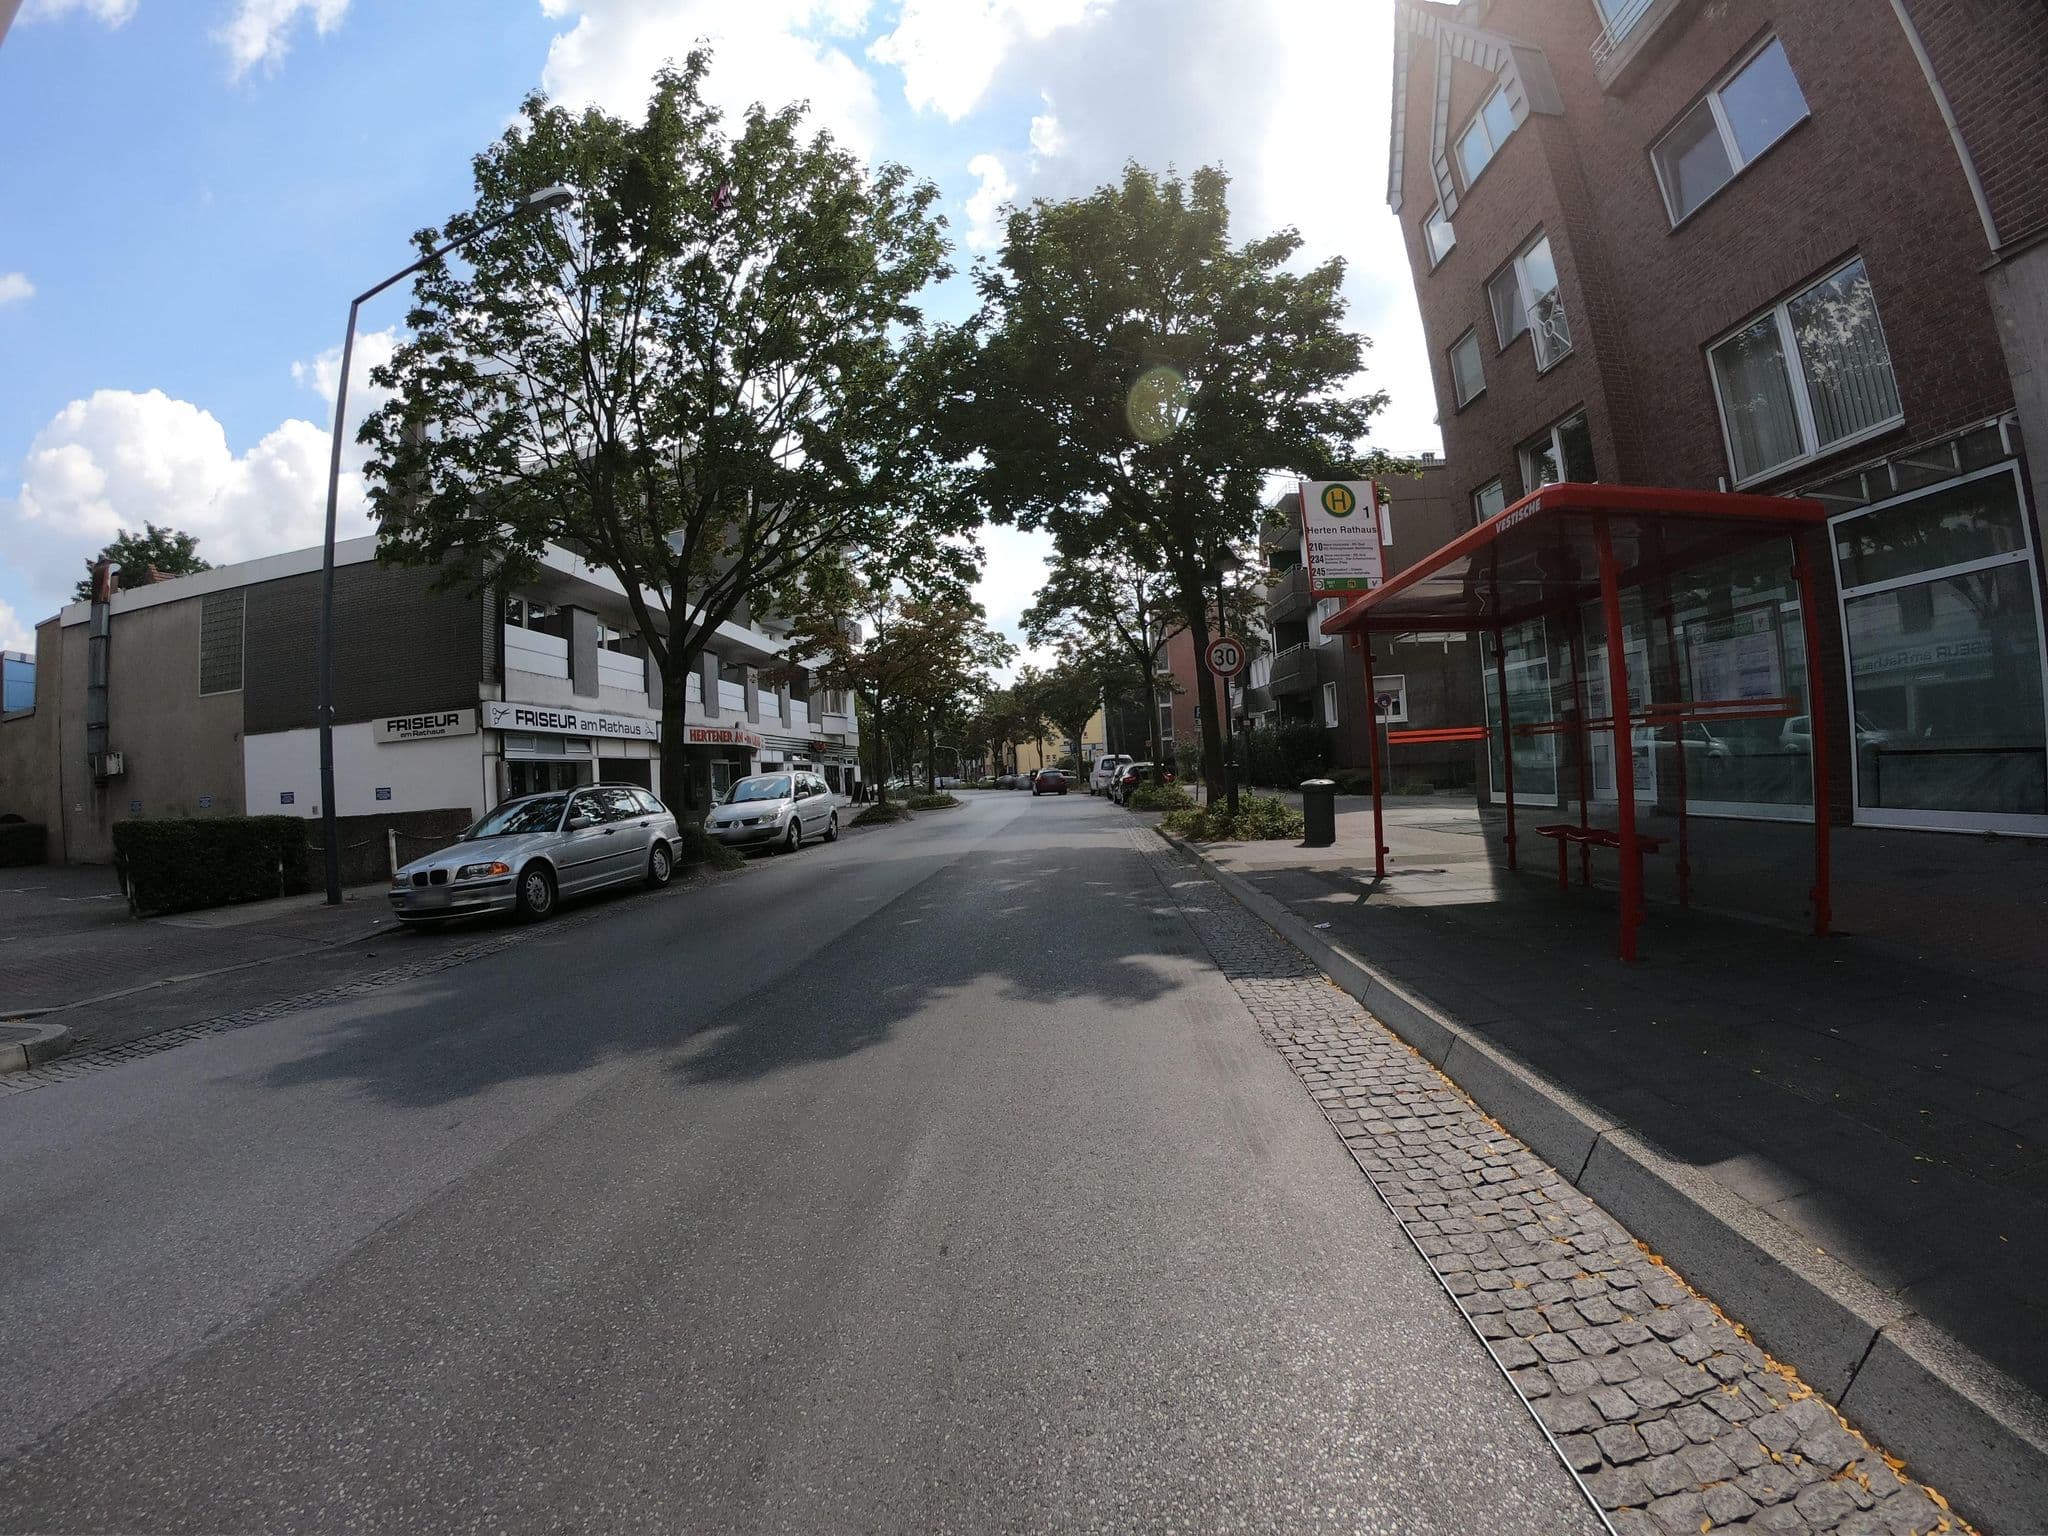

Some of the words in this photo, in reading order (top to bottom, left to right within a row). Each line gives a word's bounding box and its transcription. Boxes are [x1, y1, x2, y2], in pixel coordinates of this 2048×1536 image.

[1331, 491, 1346, 510] H
[1363, 506, 1369, 518] 1
[1495, 496, 1541, 534] VESTISCHE
[1307, 526, 1337, 534] Herten
[1340, 526, 1377, 534] Rathaus
[1309, 543, 1323, 551] 210
[1310, 555, 1324, 564] 234
[1311, 568, 1326, 577] 245
[1214, 648, 1236, 666] 30
[387, 713, 459, 733] FRISEUR
[515, 709, 577, 730] FRISEUR
[580, 721, 597, 731] am
[599, 720, 641, 735] Rathaus
[412, 728, 446, 738] Rathaus
[689, 729, 733, 743] HERTENER
